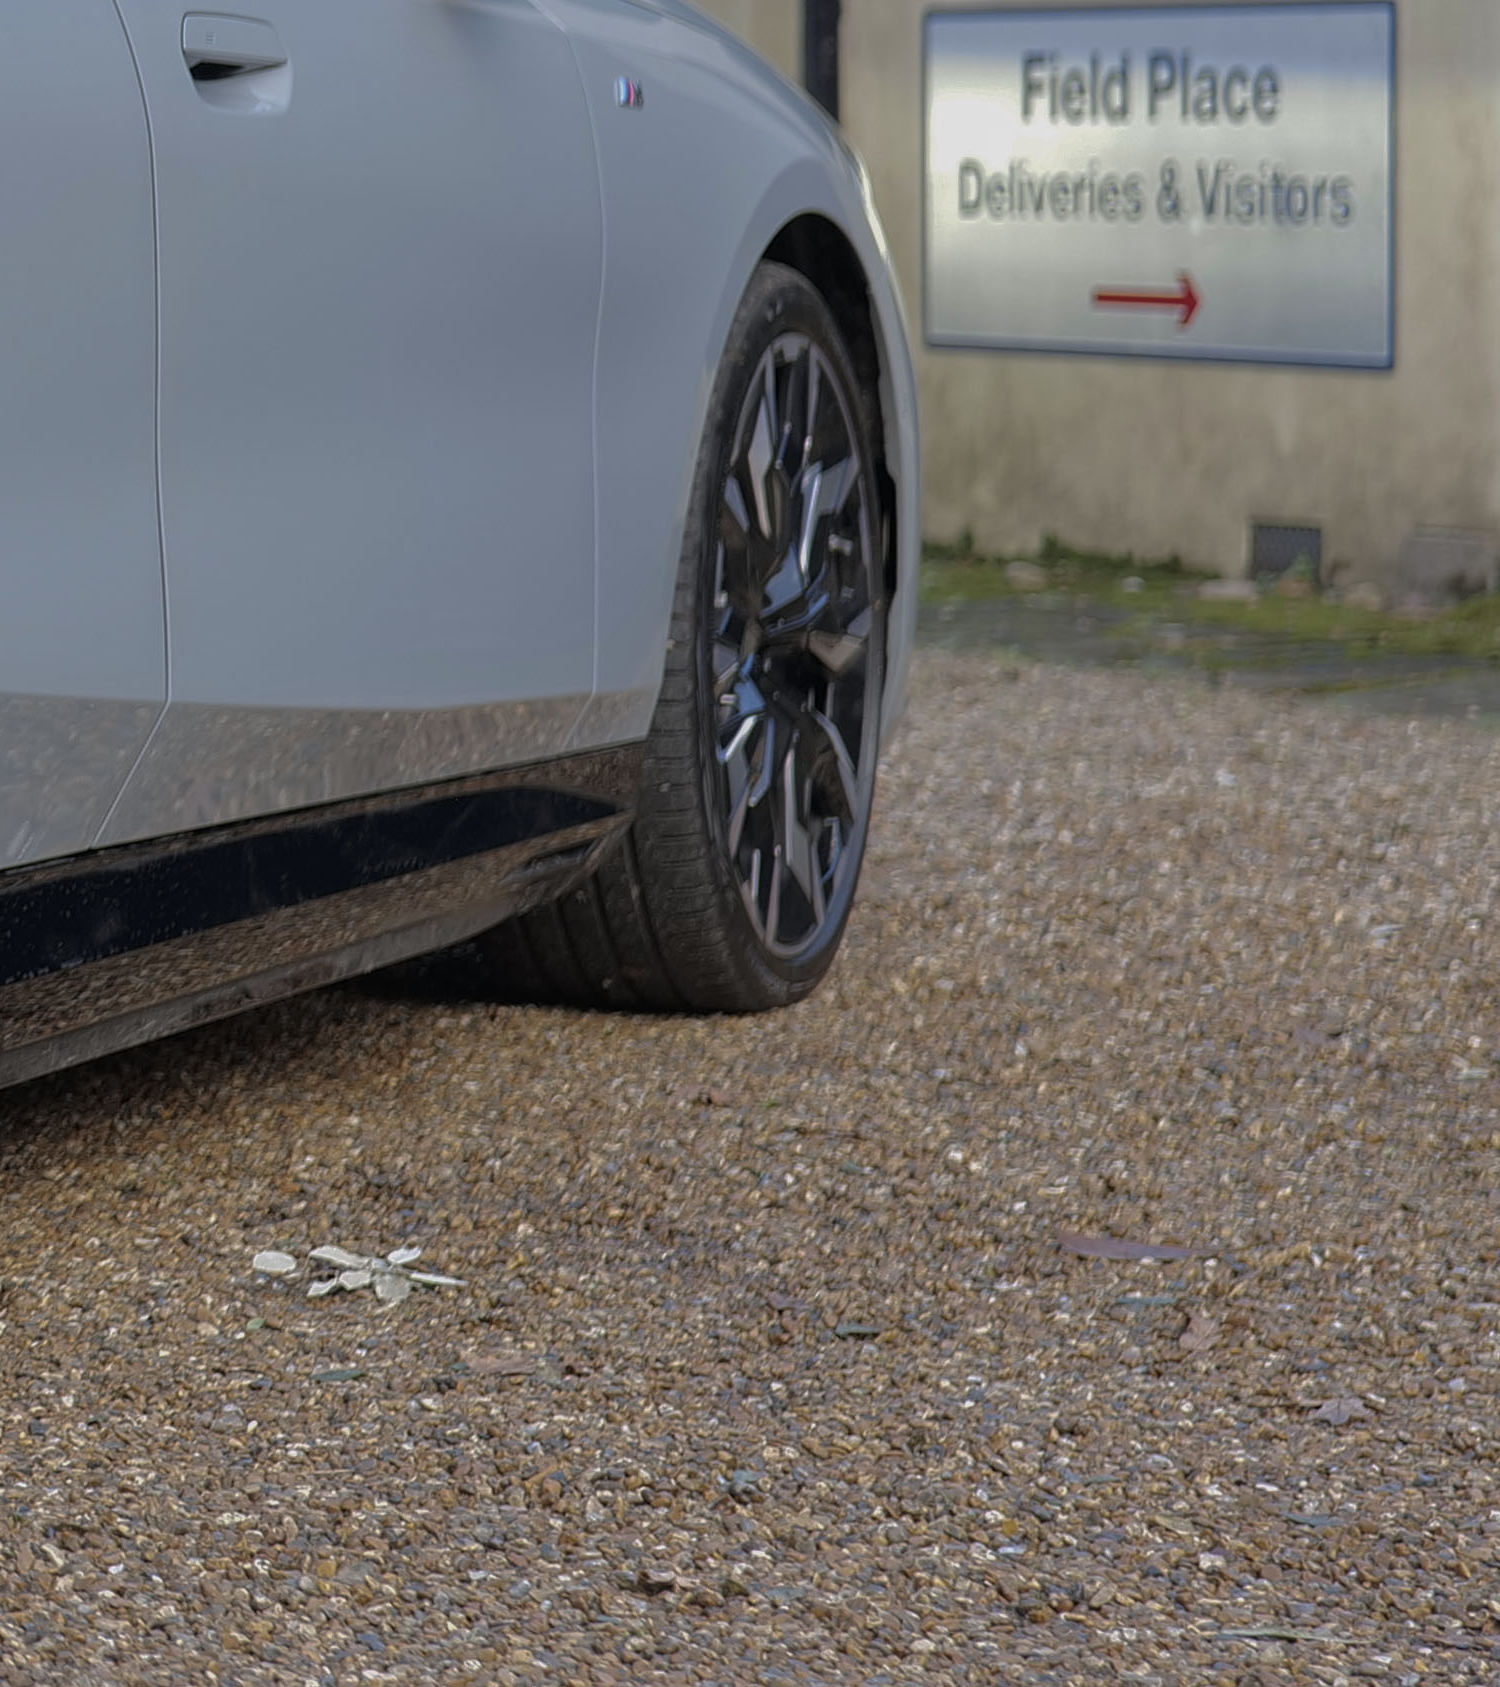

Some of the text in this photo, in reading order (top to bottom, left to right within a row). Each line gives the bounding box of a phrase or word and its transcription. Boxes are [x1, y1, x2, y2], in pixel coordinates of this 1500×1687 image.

[1020, 48, 1281, 126] Field Place
[958, 157, 1355, 227] Deliveries & Visitors
